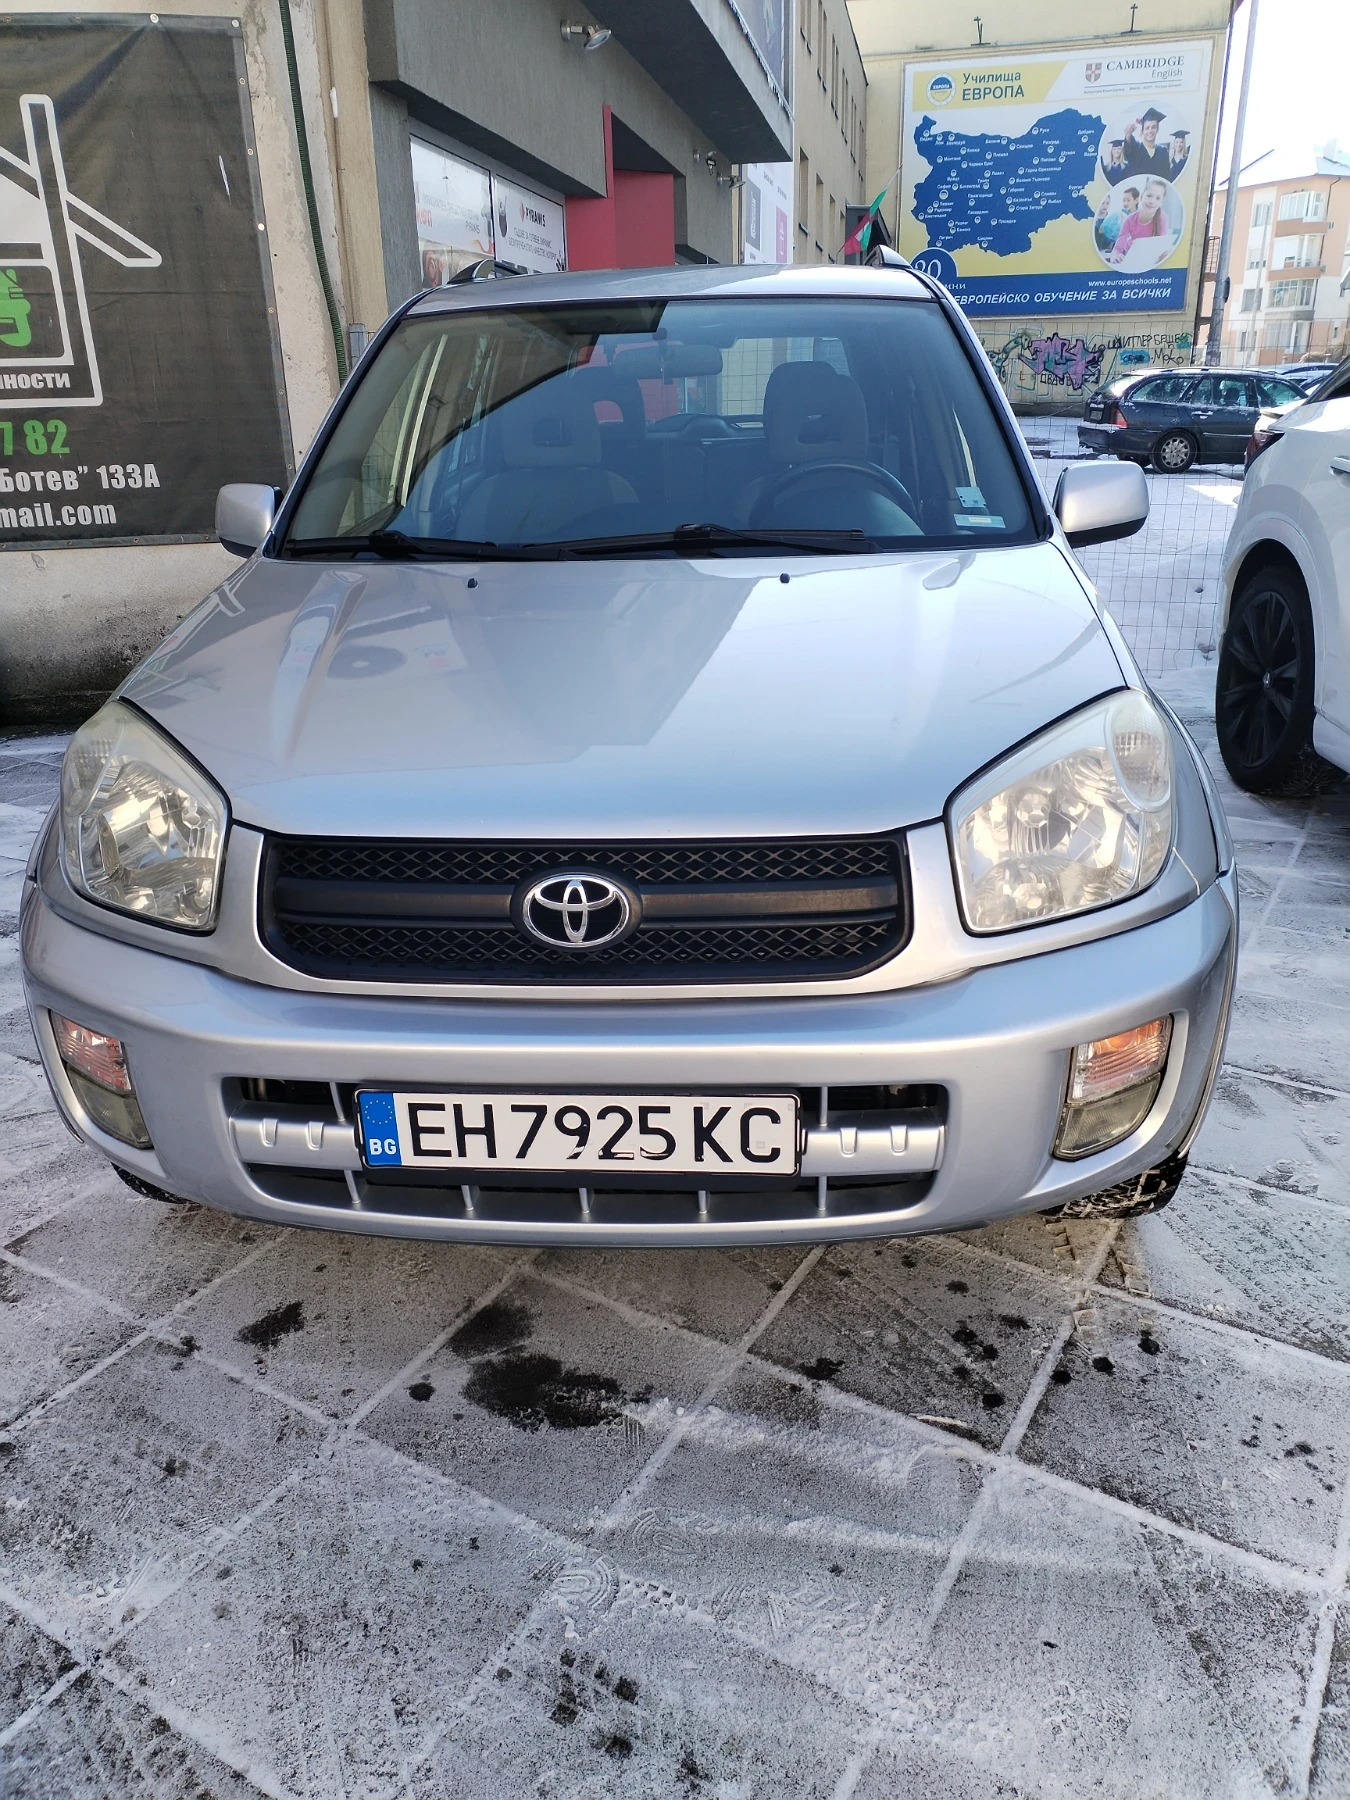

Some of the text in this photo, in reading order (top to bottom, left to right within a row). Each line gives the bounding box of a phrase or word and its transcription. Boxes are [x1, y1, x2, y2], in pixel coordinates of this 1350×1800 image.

[1106, 55, 1185, 71] CAMBRIDGE
[963, 72, 1021, 84] Училища
[1151, 68, 1183, 79] English
[962, 84, 1025, 101] ЕВРОПА
[1088, 277, 1172, 287] www.europeschools.net
[955, 288, 1171, 305] ЕВРОПЕЙСКО ОБУЧЕНИЕ ЗА ВСИЧКИ
[23, 419, 70, 455] 82
[95, 463, 161, 489] 133А
[407, 1102, 781, 1163] EH 7925 KC
[369, 1138, 397, 1156] BG
